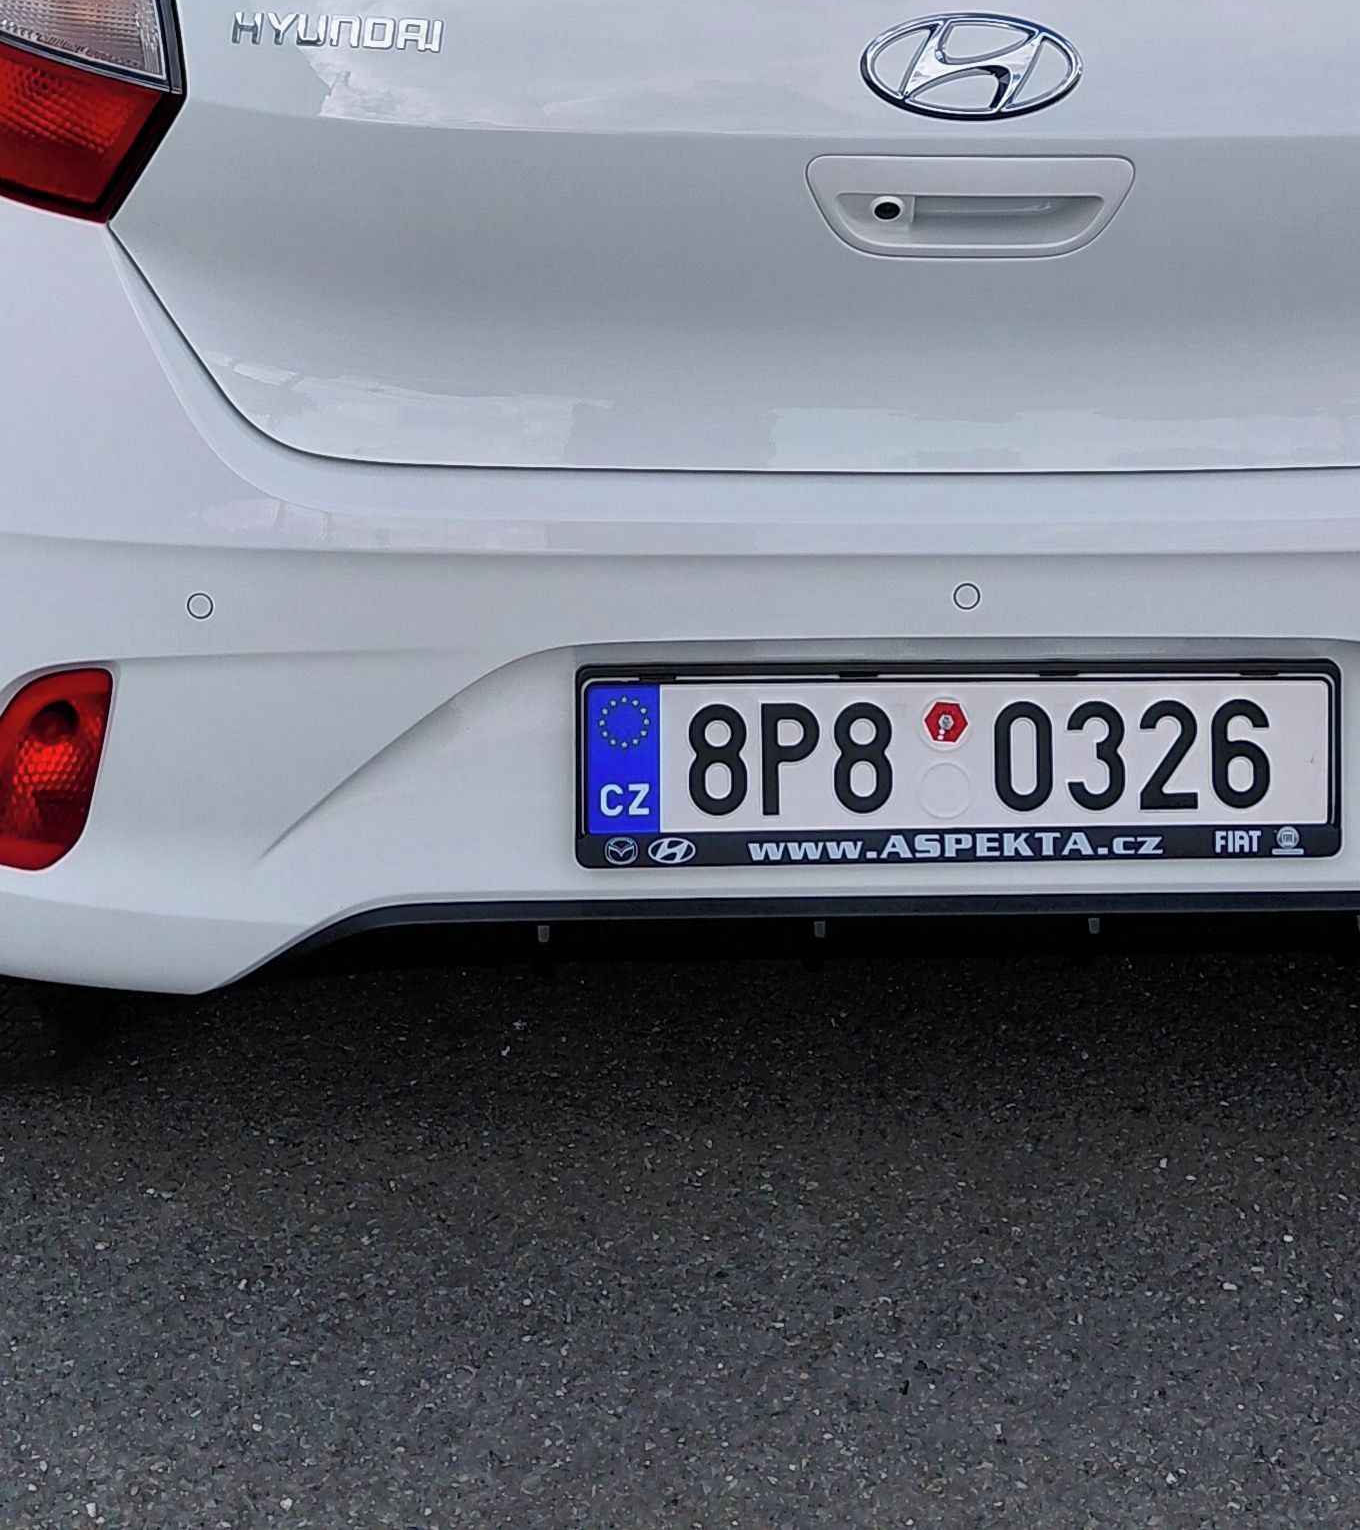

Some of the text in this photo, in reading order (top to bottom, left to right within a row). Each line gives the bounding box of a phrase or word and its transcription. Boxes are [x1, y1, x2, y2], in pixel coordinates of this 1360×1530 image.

[232, 11, 444, 54] HYUNDAI
[687, 697, 1272, 816] 8P8 0326
[598, 783, 650, 817] CZ
[1214, 830, 1262, 853] FIAT
